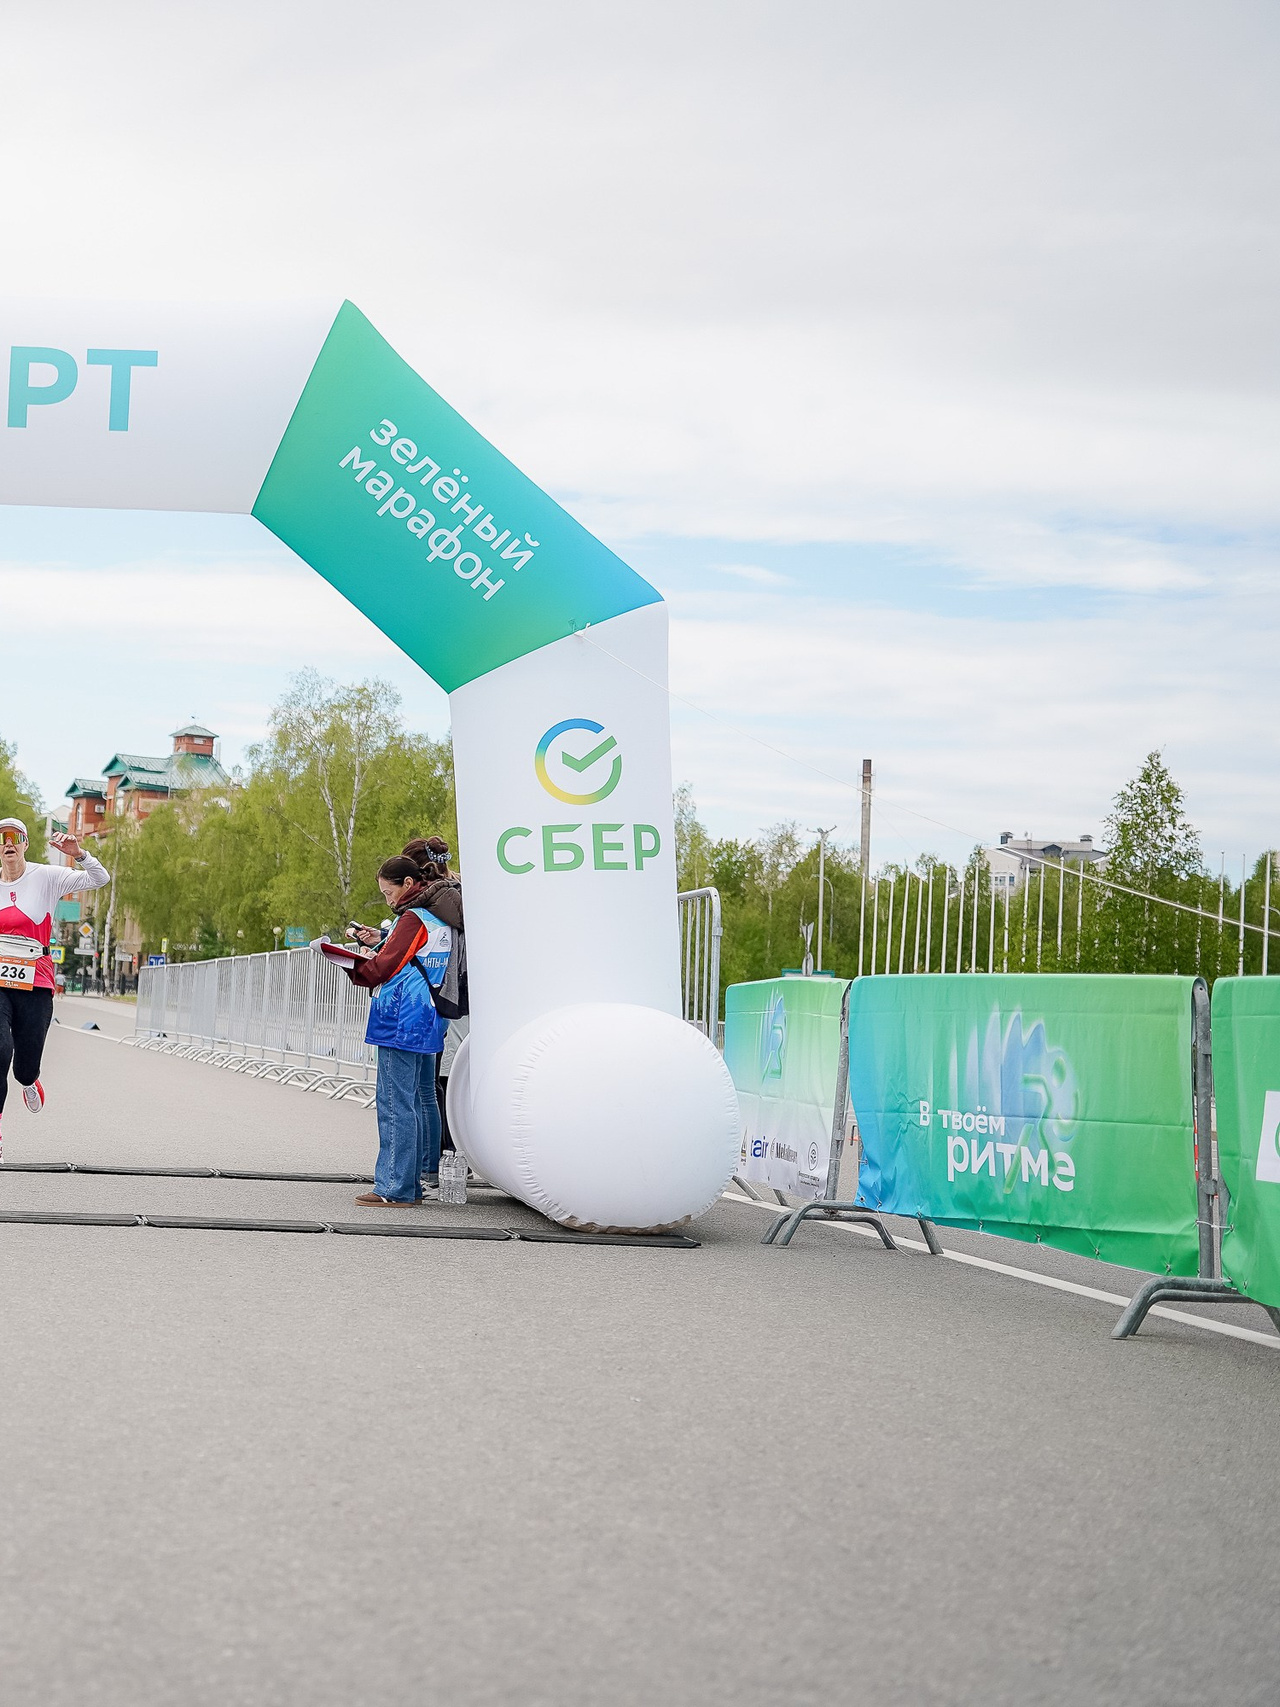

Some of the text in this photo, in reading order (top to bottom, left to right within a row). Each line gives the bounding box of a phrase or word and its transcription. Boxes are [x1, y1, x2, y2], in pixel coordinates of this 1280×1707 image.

[369, 418, 540, 572] зелёный
[338, 445, 506, 602] марафон
[496, 823, 661, 875] СБЕР
[0, 965, 26, 980] 236
[919, 1100, 1006, 1136] В твоём
[947, 1135, 1076, 1192] ритме
